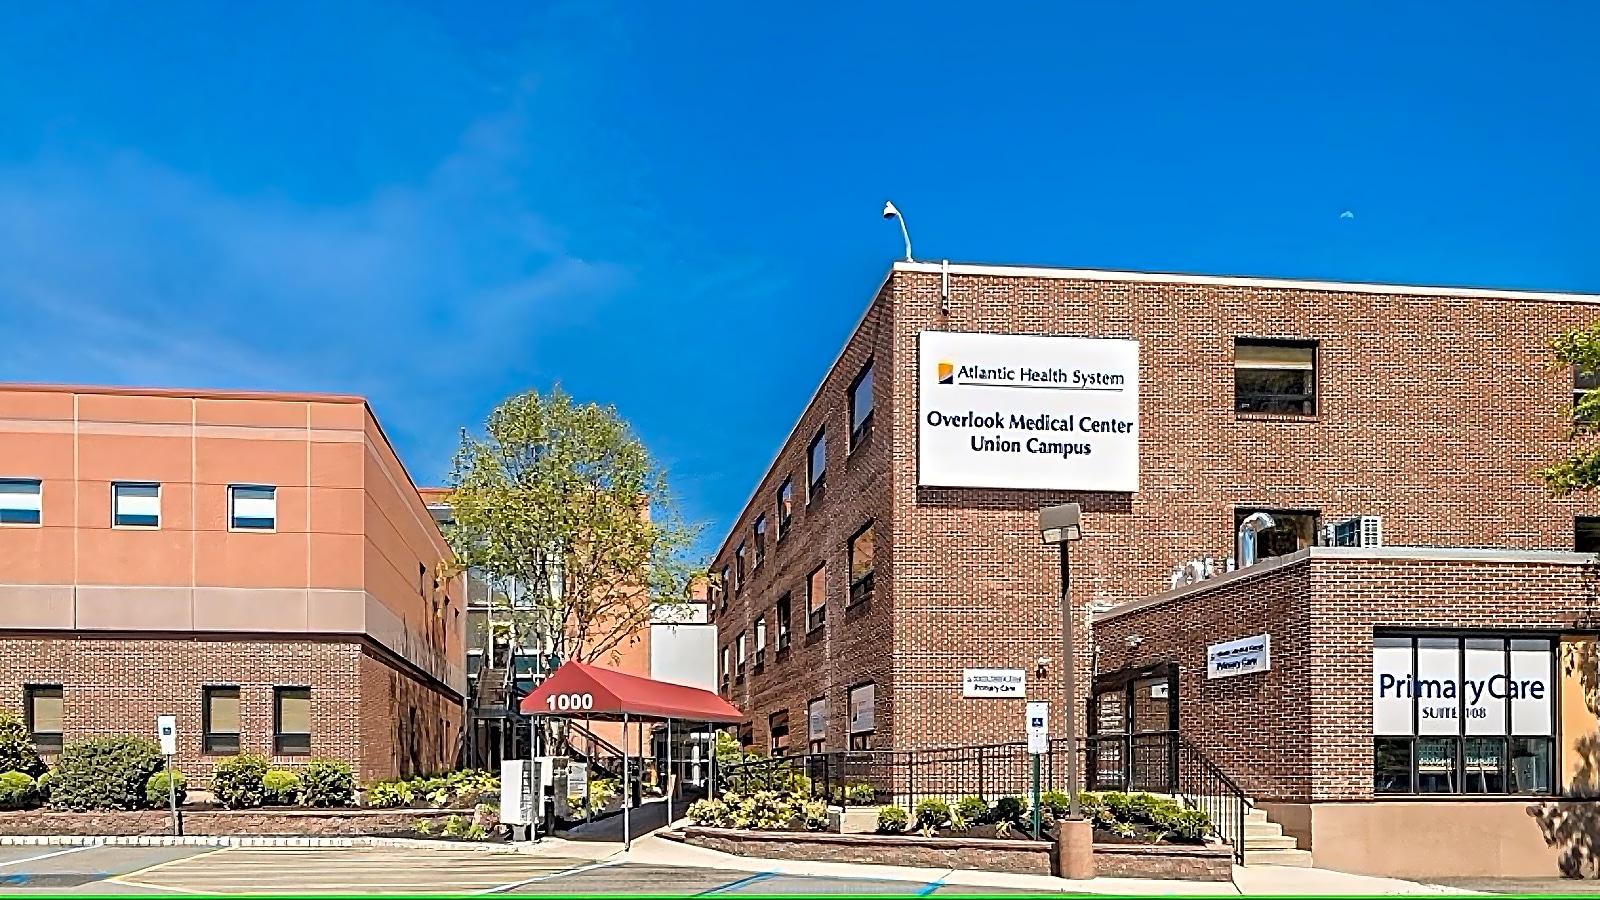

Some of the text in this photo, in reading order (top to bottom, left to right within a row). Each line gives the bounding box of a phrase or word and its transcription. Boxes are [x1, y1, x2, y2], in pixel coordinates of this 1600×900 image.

[957, 365, 1124, 388] Atlantic Health System
[927, 411, 1133, 433] Overlook Medical Center
[971, 435, 1091, 459] Union Campus
[1379, 673, 1545, 705] Primary Care
[547, 693, 593, 711] 1000
[1422, 706, 1487, 719] SUITE 108
